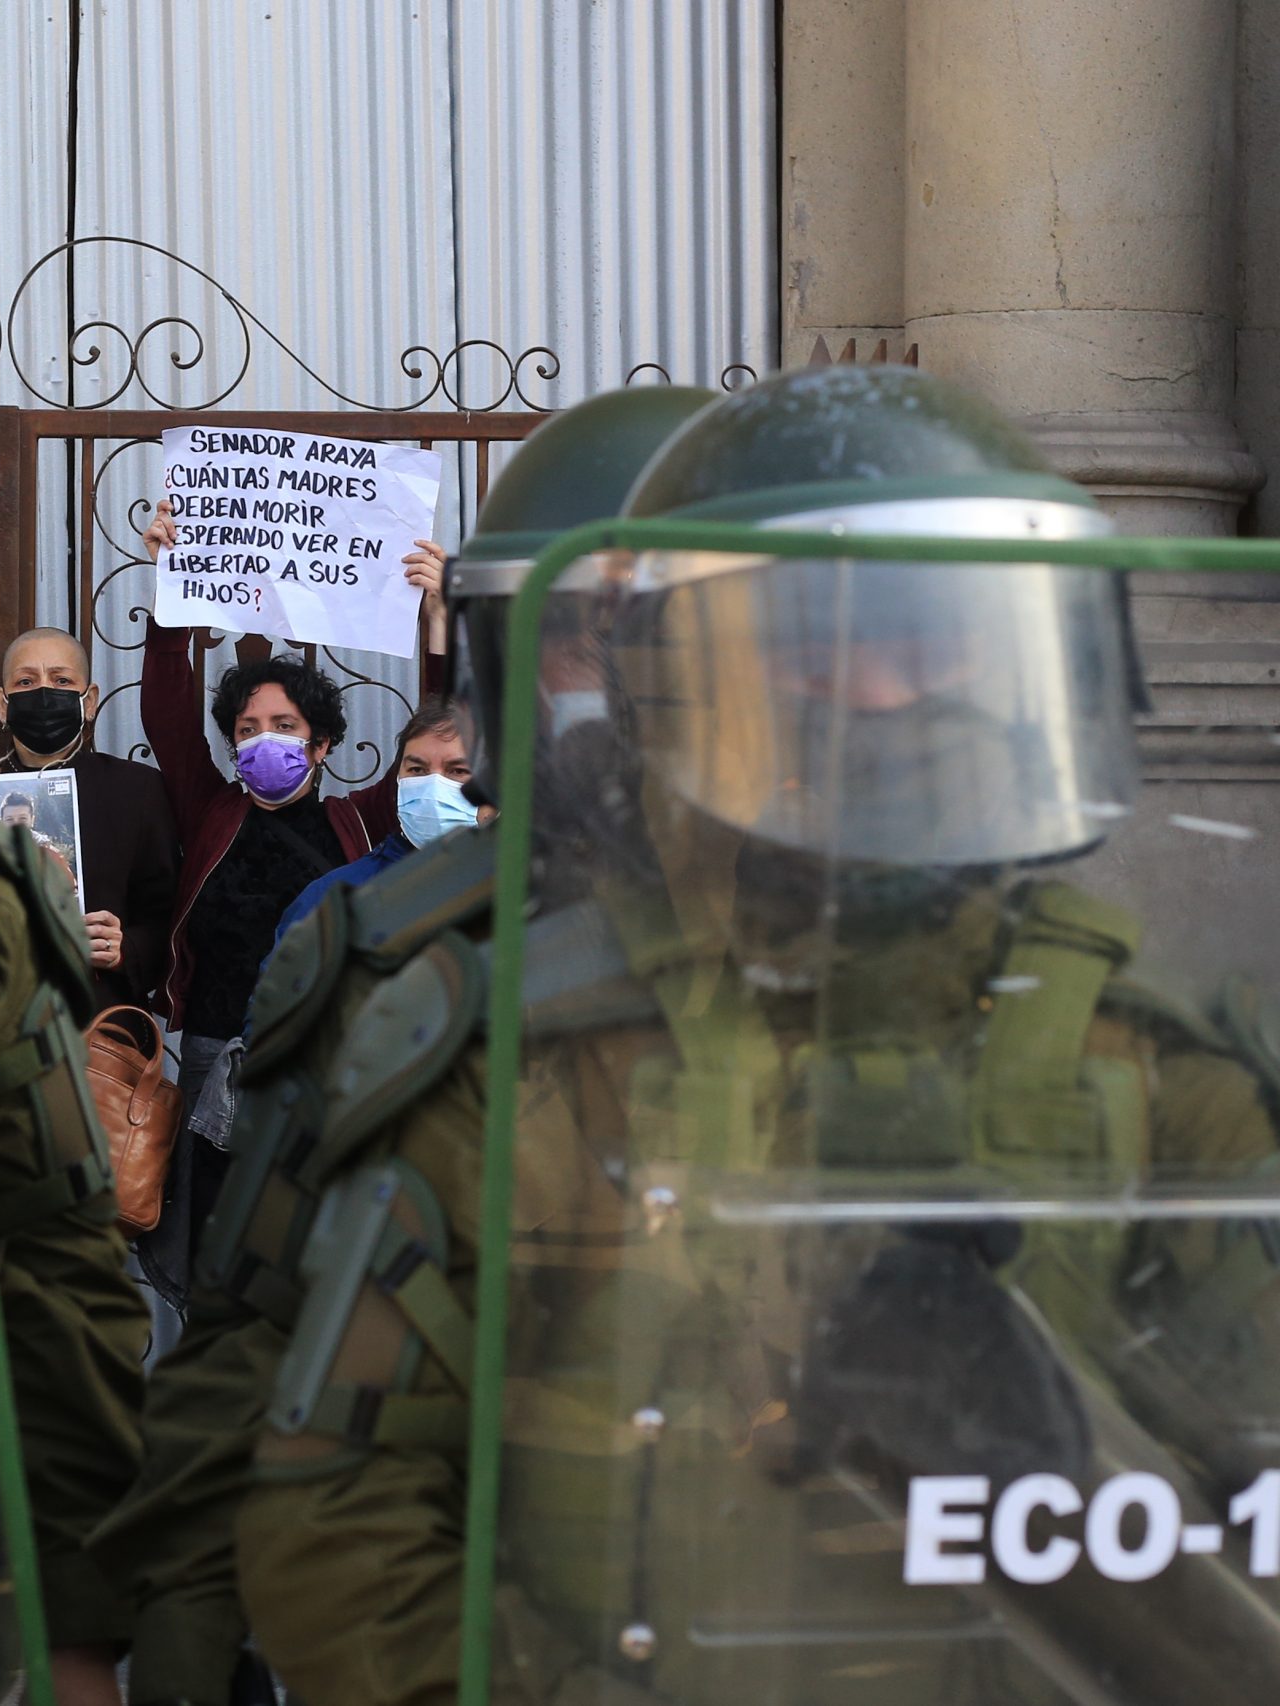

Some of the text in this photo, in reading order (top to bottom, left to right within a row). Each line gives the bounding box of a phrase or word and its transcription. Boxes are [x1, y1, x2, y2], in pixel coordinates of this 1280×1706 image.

[190, 429, 377, 470] SENADOR ARAYA
[165, 461, 377, 502] ¿CUÁNTAS MADRES
[169, 493, 326, 528] DEBEN MORIR
[292, 532, 338, 554] VER
[348, 537, 383, 560] EN
[169, 552, 360, 586] LIBERTAD A SUS
[903, 1467, 1280, 1586] ECO-1
